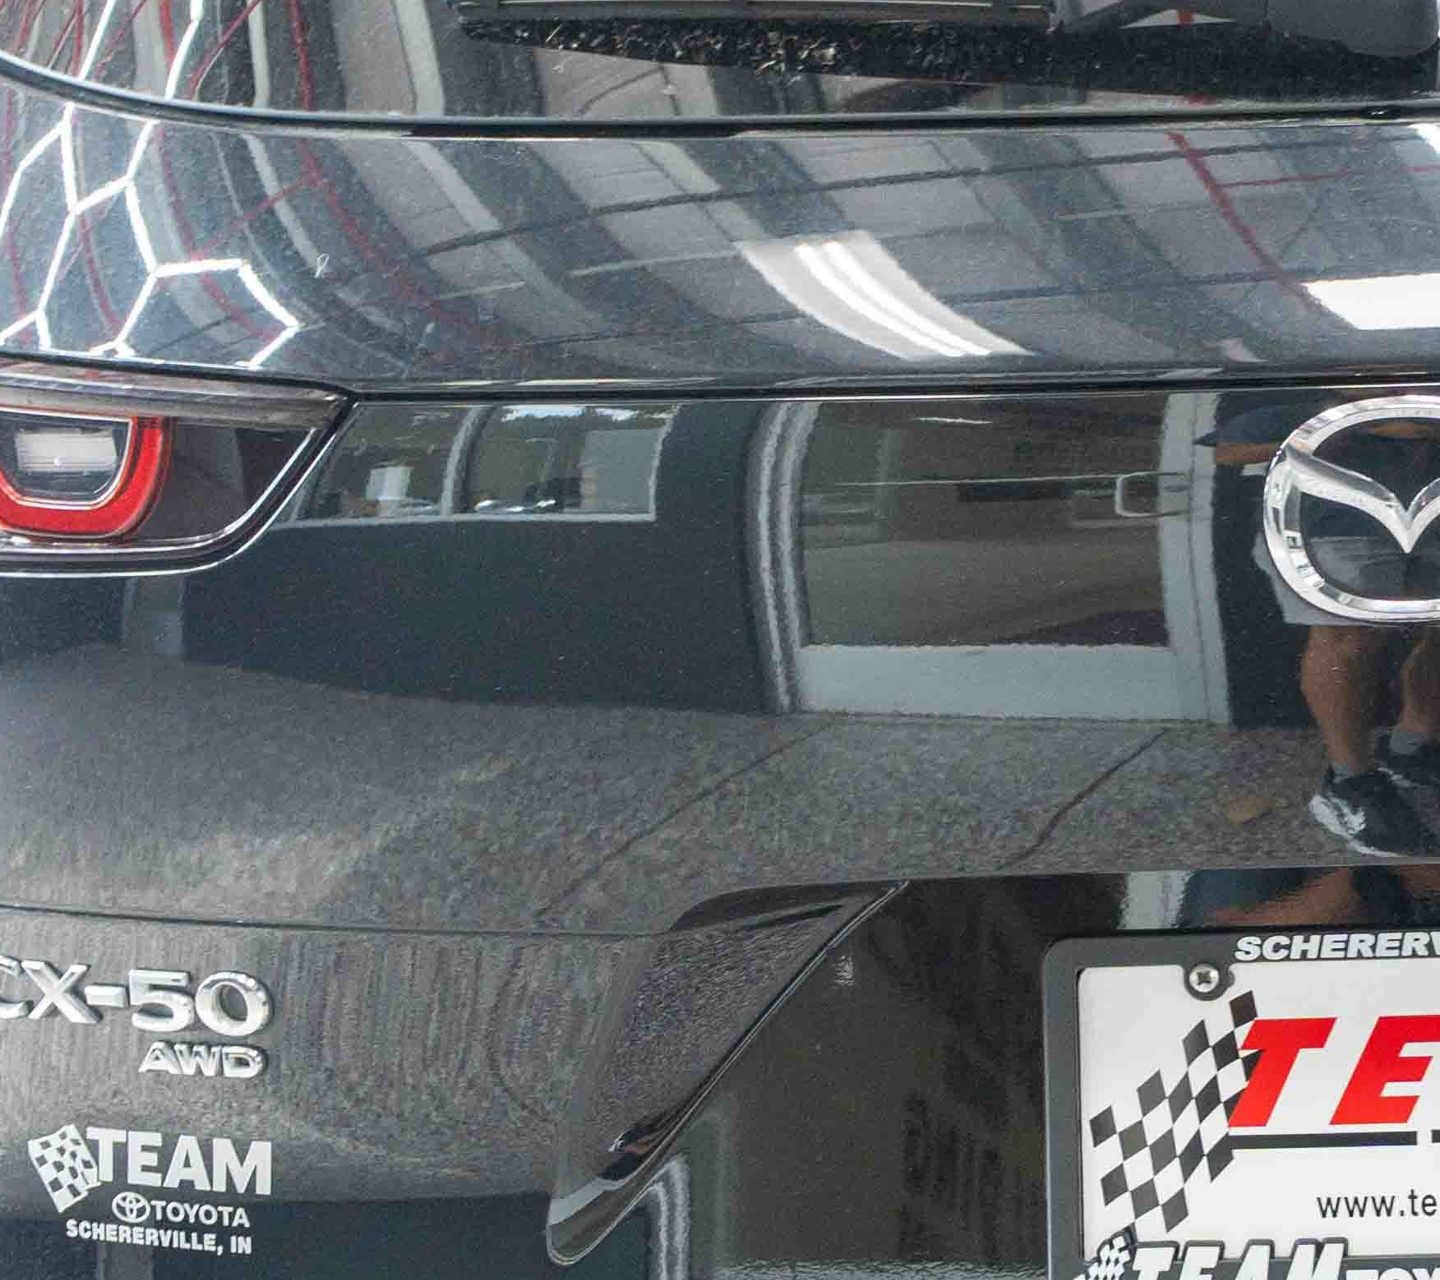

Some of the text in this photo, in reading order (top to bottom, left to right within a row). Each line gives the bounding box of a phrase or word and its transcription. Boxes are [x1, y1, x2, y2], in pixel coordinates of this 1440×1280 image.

[138, 1041, 264, 1078] AWD
[86, 1126, 272, 1195] TEAM
[151, 1199, 250, 1228] TOYOTA
[66, 1219, 252, 1256] SCHERERVILLE, IN
